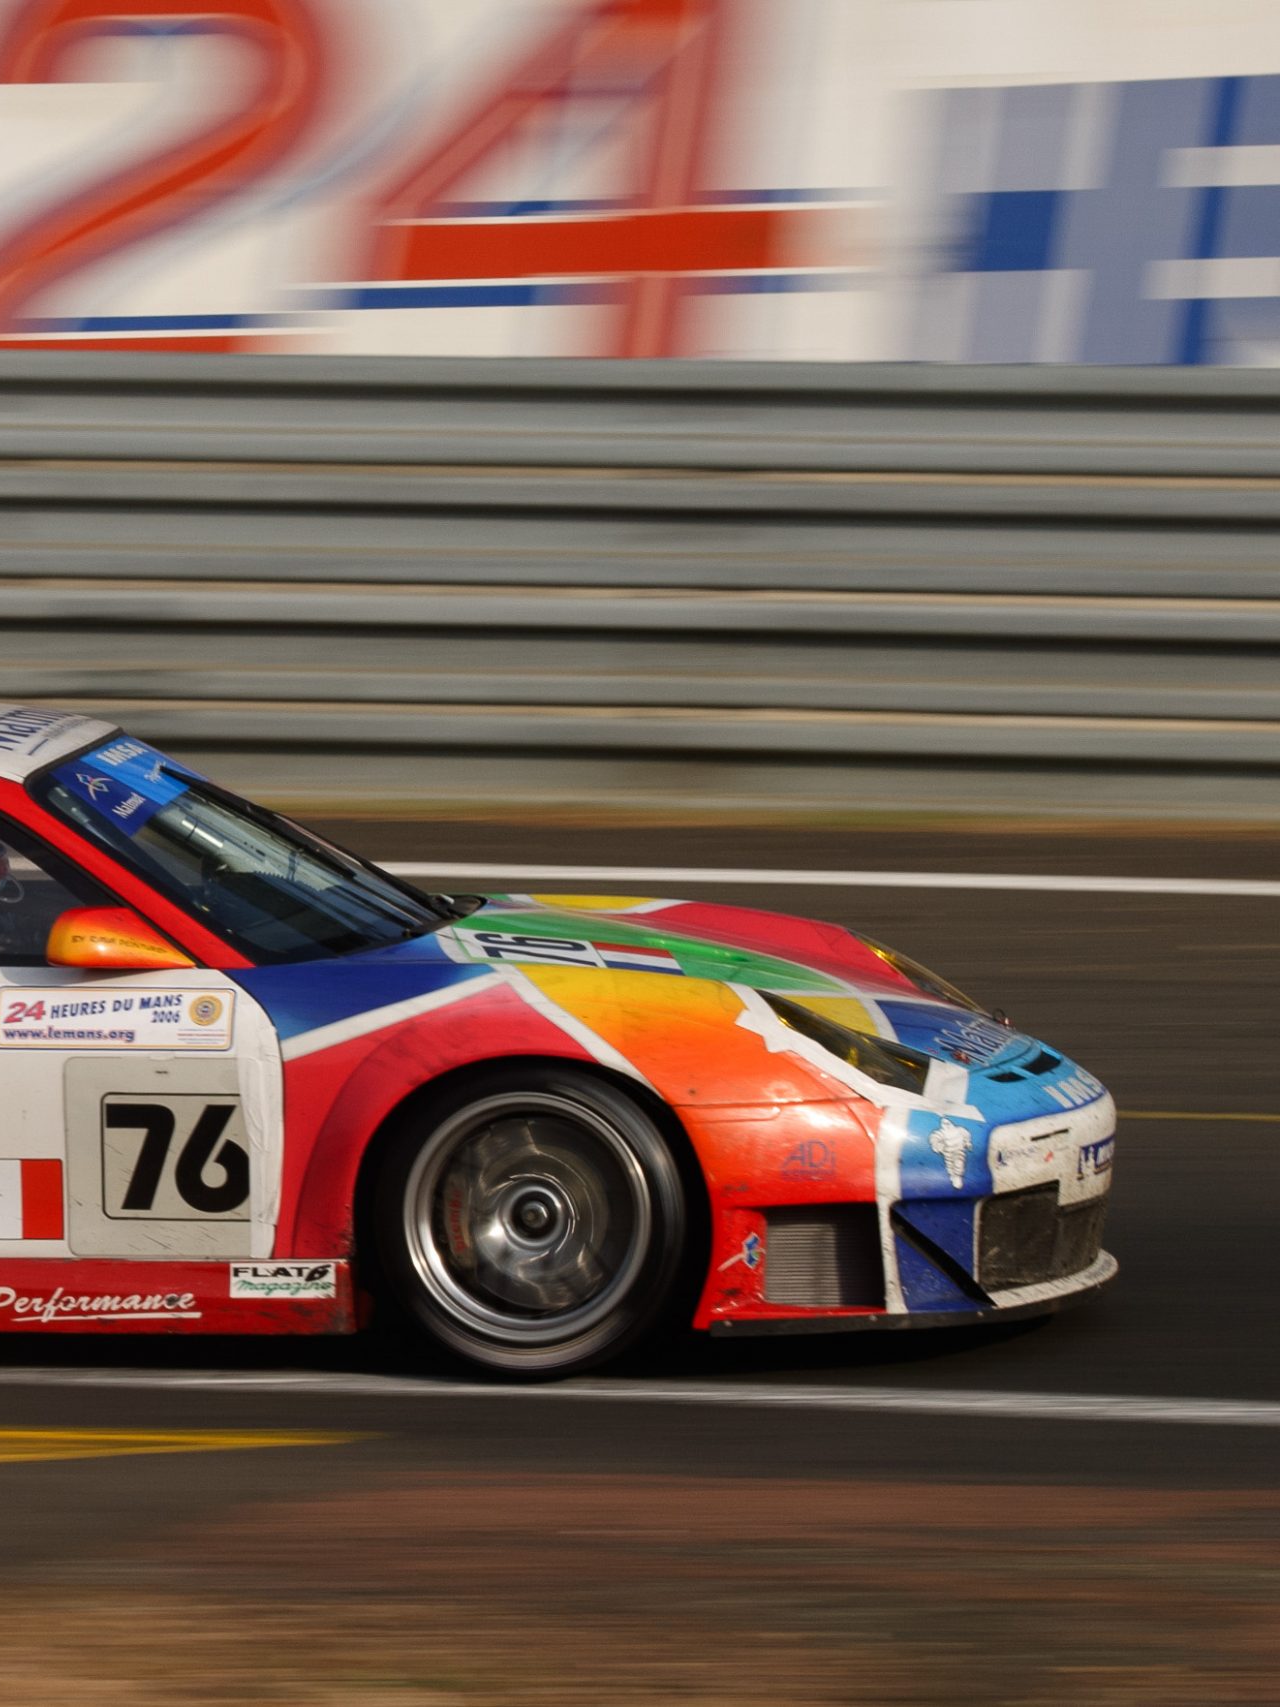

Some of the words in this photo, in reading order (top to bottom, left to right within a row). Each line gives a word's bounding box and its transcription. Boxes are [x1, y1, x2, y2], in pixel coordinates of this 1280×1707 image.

[474, 932, 599, 967] 76
[3, 1001, 46, 1024] 24
[50, 1001, 106, 1019] HEURES
[112, 999, 133, 1012] DU
[139, 994, 183, 1010] MANS
[151, 1010, 181, 1023] 2006
[3, 1027, 136, 1043] www.lemans.org
[105, 1103, 251, 1214] 76
[232, 1264, 332, 1282] FLAT6
[234, 1280, 336, 1296] magazine
